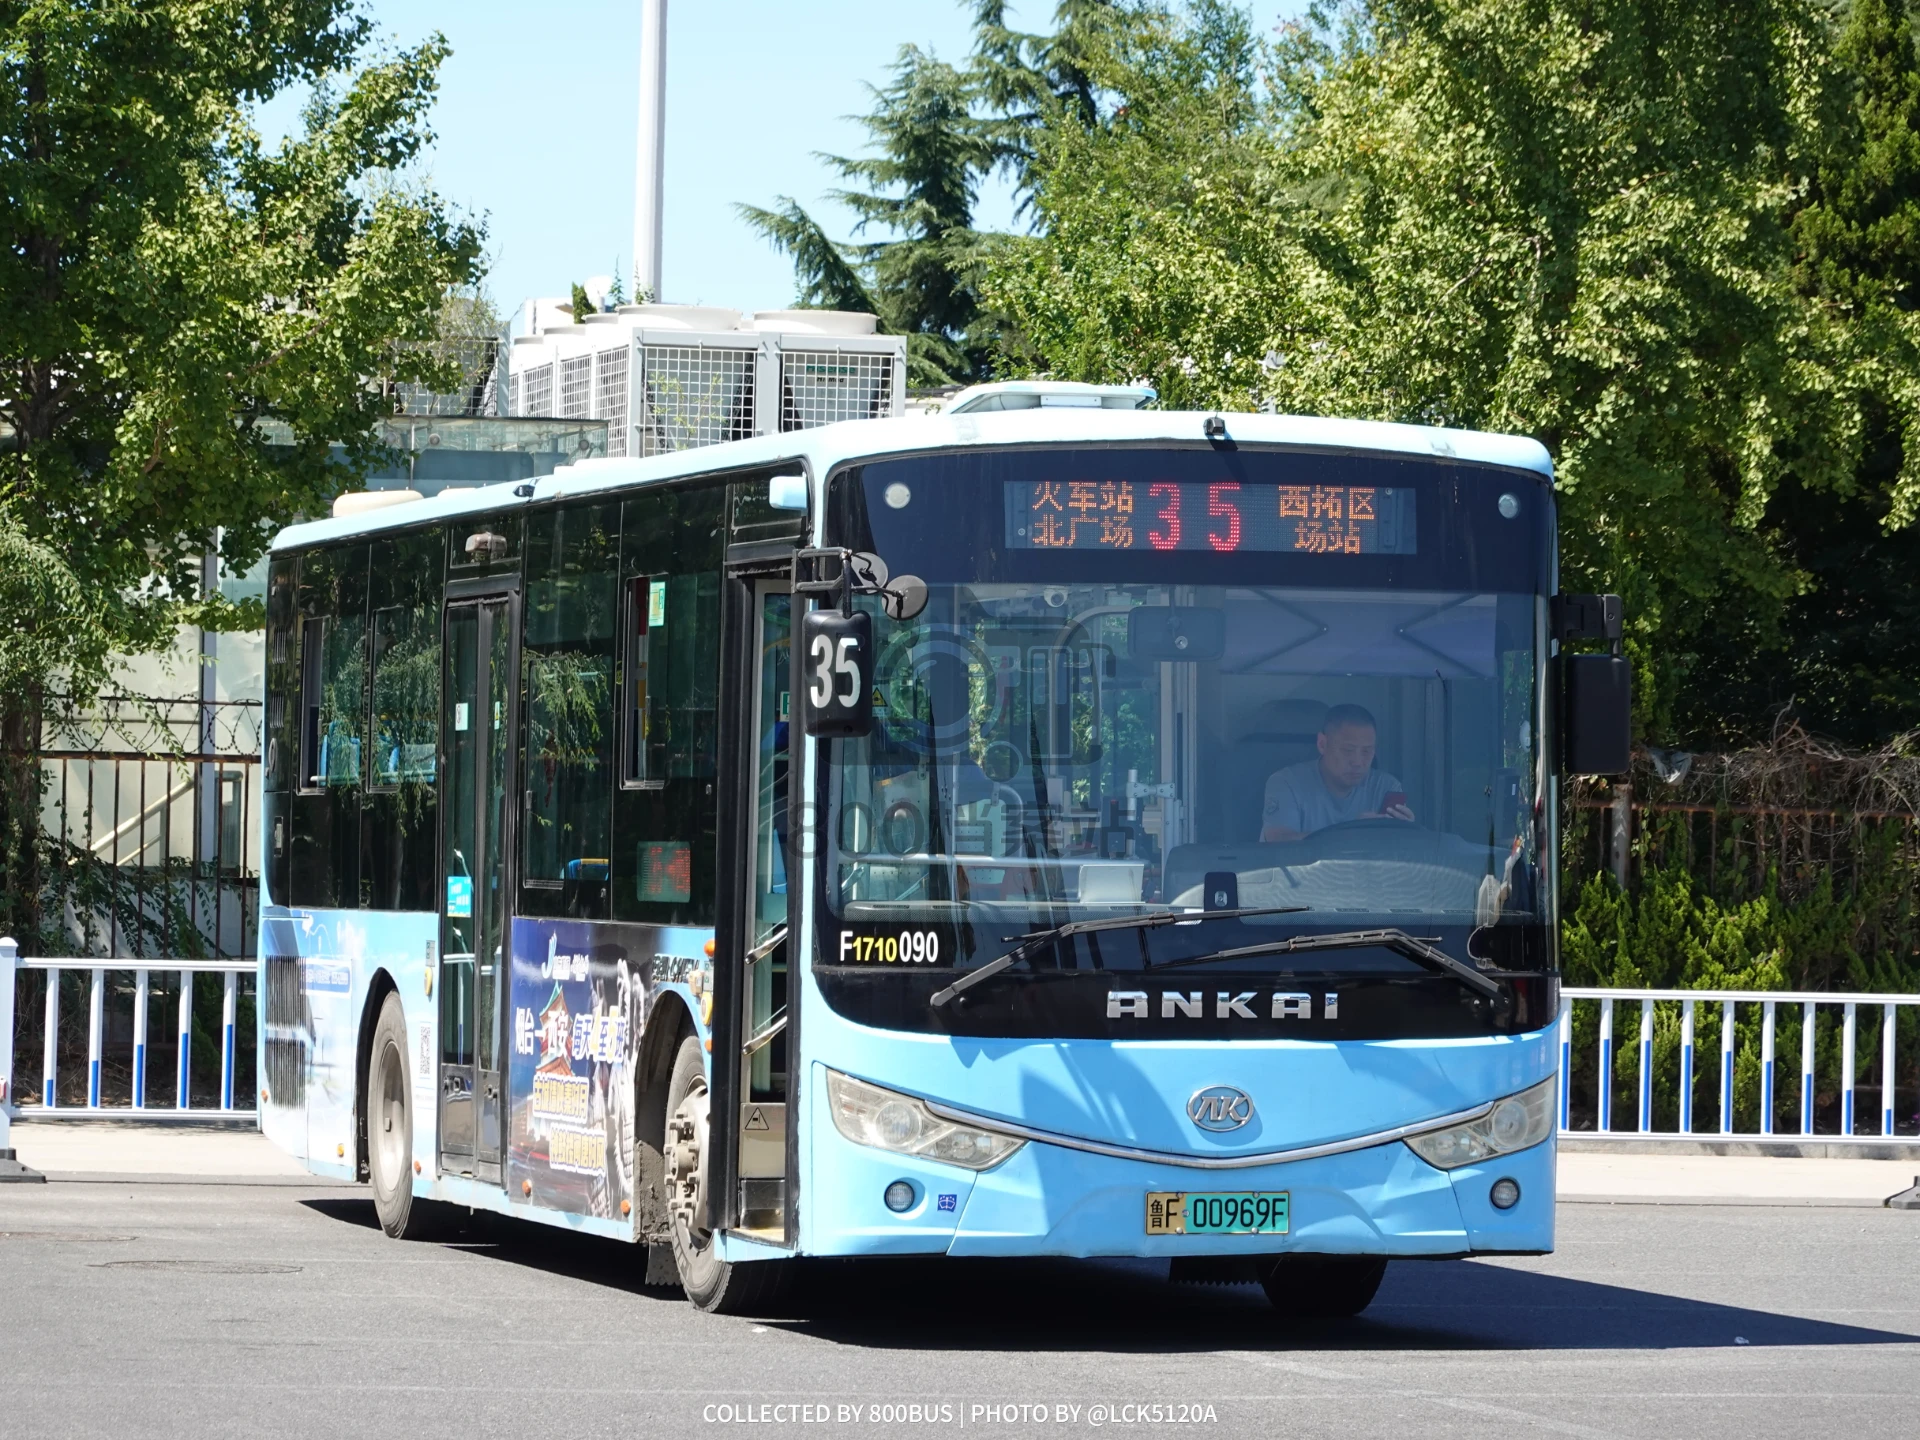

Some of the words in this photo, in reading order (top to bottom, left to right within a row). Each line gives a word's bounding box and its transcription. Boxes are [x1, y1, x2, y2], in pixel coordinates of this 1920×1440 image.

[1032, 481, 1133, 513] 火车站
[1278, 485, 1375, 520] 西拓区
[1032, 514, 1133, 548] 北广场
[1294, 521, 1361, 555] 场站
[810, 633, 862, 709] 35
[839, 930, 940, 965] F1710090
[1107, 990, 1339, 1020] ANKAI
[1192, 1197, 1287, 1229] 00969F
